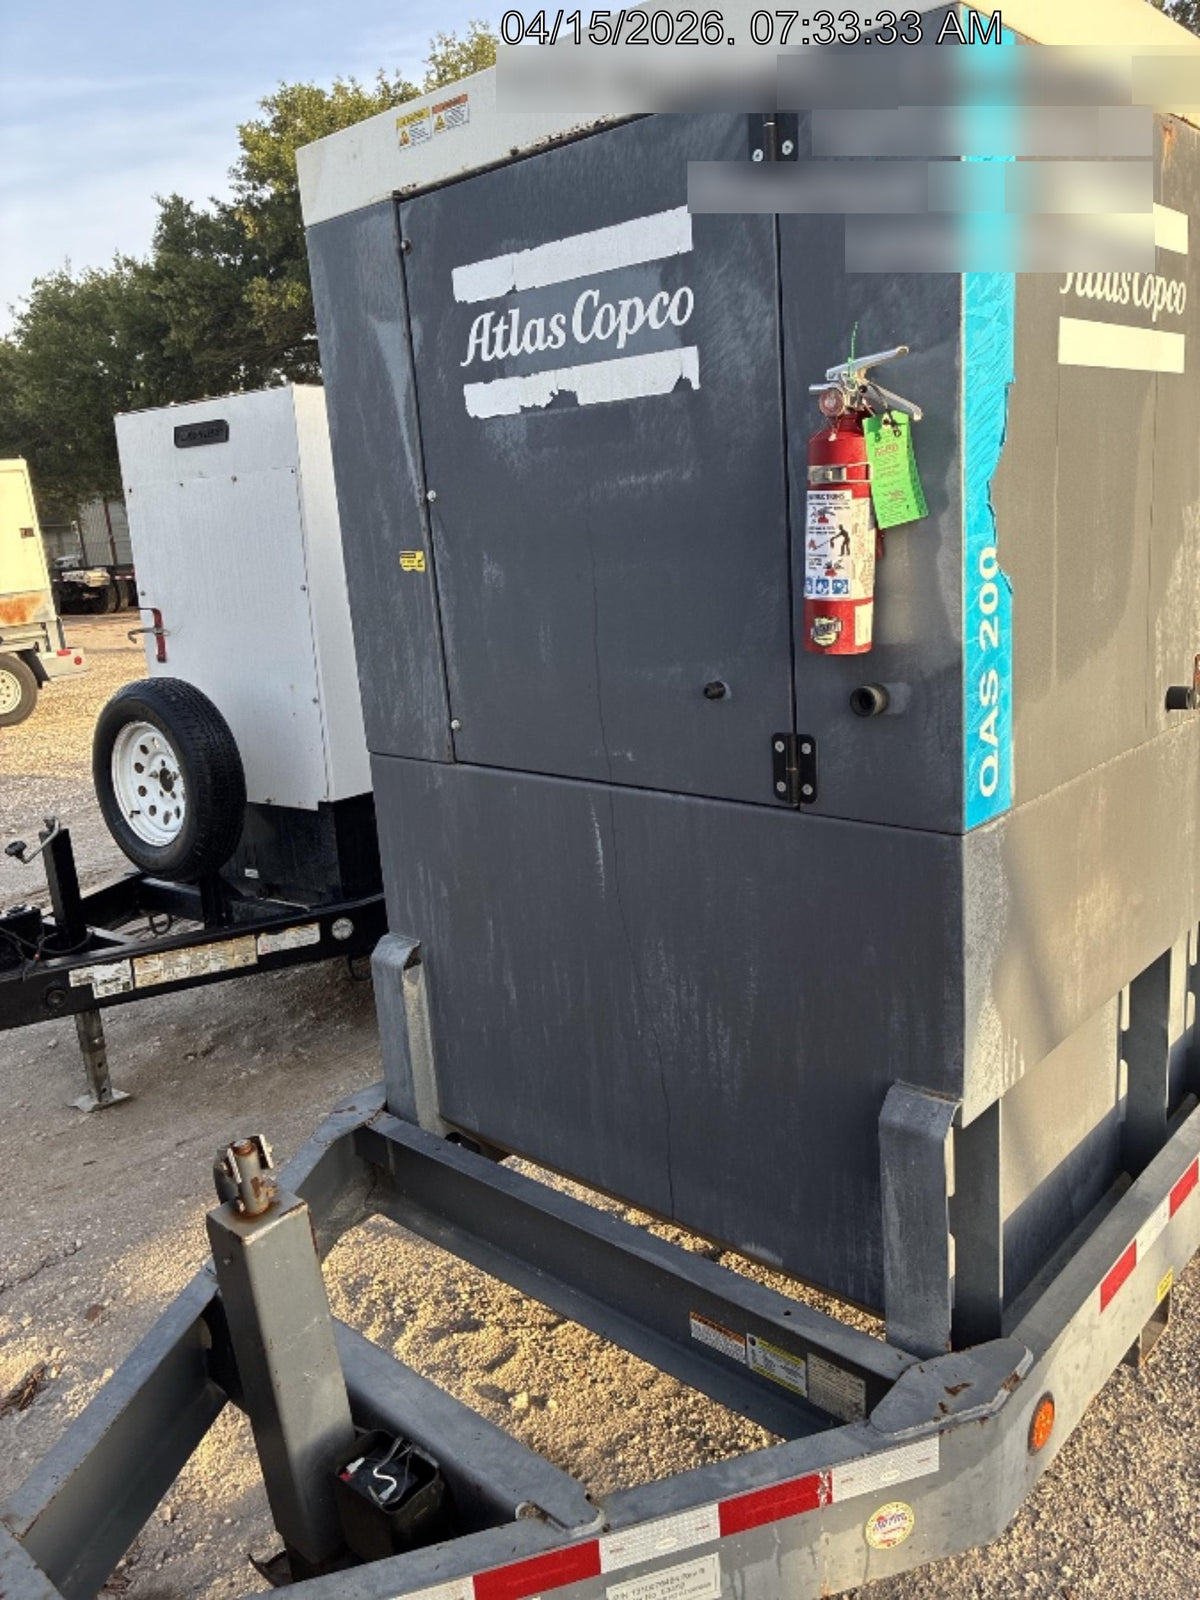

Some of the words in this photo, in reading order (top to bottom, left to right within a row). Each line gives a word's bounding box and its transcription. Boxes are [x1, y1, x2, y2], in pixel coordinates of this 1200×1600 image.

[460, 307, 566, 367] Atlas
[572, 286, 694, 349] Copco
[978, 546, 999, 651] 200
